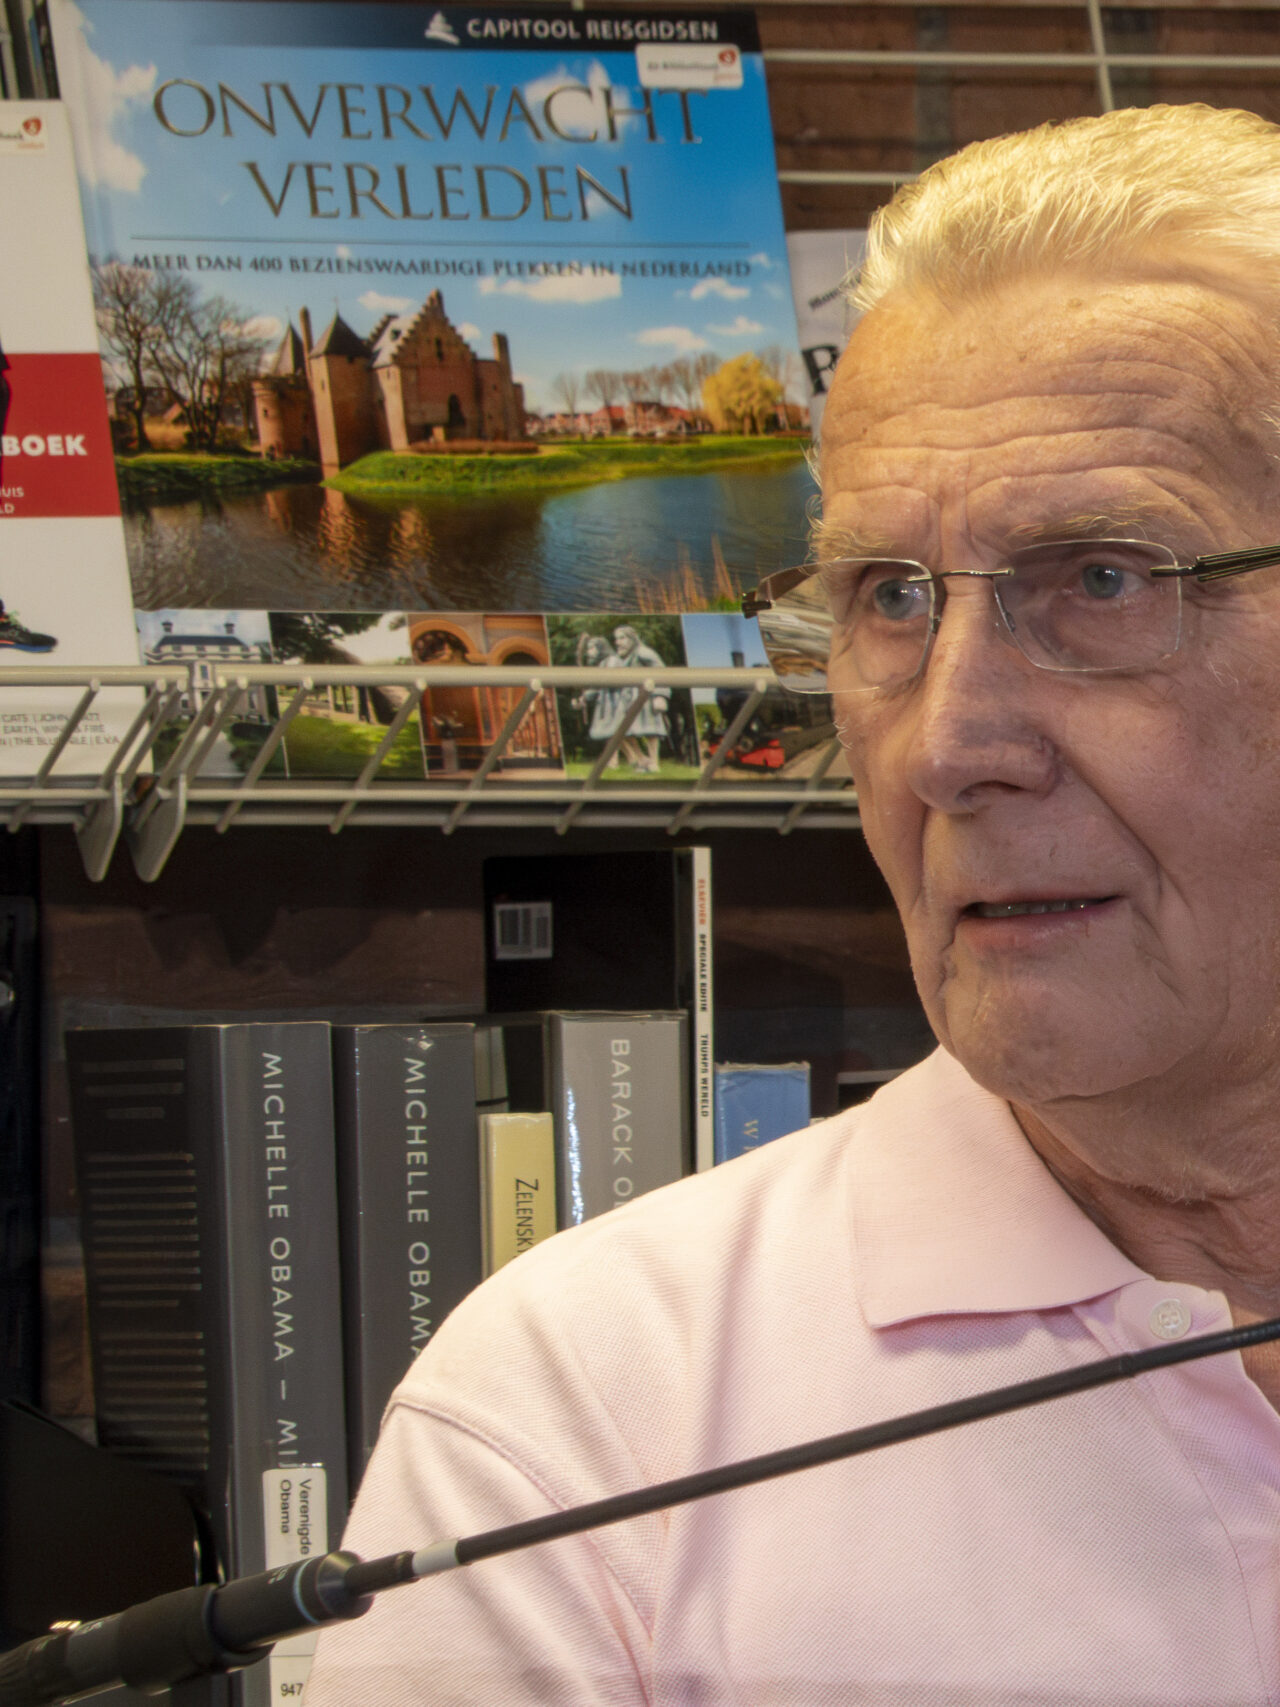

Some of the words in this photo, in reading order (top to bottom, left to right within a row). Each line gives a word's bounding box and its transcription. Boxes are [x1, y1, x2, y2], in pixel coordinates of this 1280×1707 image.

[466, 18, 580, 40] CAPITOOL
[586, 19, 719, 41] REISGIDSEN
[152, 77, 708, 144] ONVERWACHT
[240, 161, 634, 221] VERLEDEN
[132, 253, 190, 271] MEER
[196, 254, 242, 272] DAN
[249, 256, 282, 273] 400
[289, 256, 486, 277] BEZIENSWAARDIGE
[493, 258, 584, 278] PLEKKEN
[591, 259, 615, 277] IN
[621, 258, 752, 279] NEDERLAND
[699, 933, 708, 980] SPECIALE
[611, 1039, 633, 1165] BARACK
[700, 1077, 710, 1118] WERELD
[262, 1051, 289, 1219] MICHELLE
[404, 1056, 430, 1223] MICHELLE
[270, 1236, 295, 1361] OBAMA
[280, 1479, 292, 1534] Obama
[297, 1478, 312, 1556] Verenigde
[280, 1683, 304, 1698] 947
